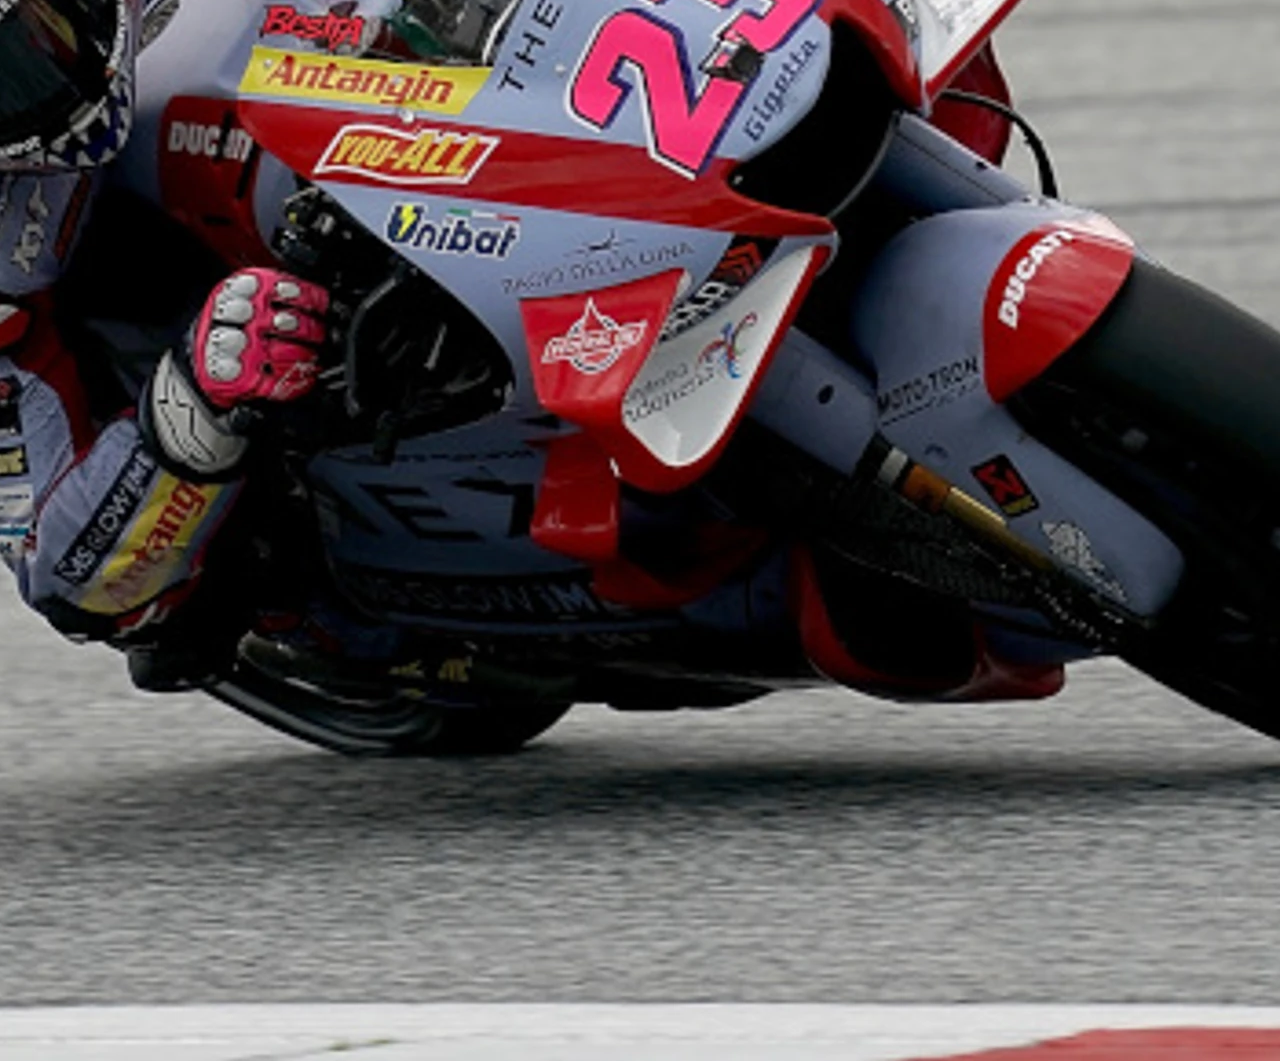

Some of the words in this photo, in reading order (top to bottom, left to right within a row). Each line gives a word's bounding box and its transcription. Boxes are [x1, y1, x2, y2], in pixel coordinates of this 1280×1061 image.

[266, 54, 455, 104] Antangin
[743, 40, 820, 142] Gigetta
[331, 132, 483, 175] YOU-ALL
[386, 203, 518, 259] Unibat
[997, 230, 1074, 329] DUCATI
[104, 480, 208, 609] Antang
